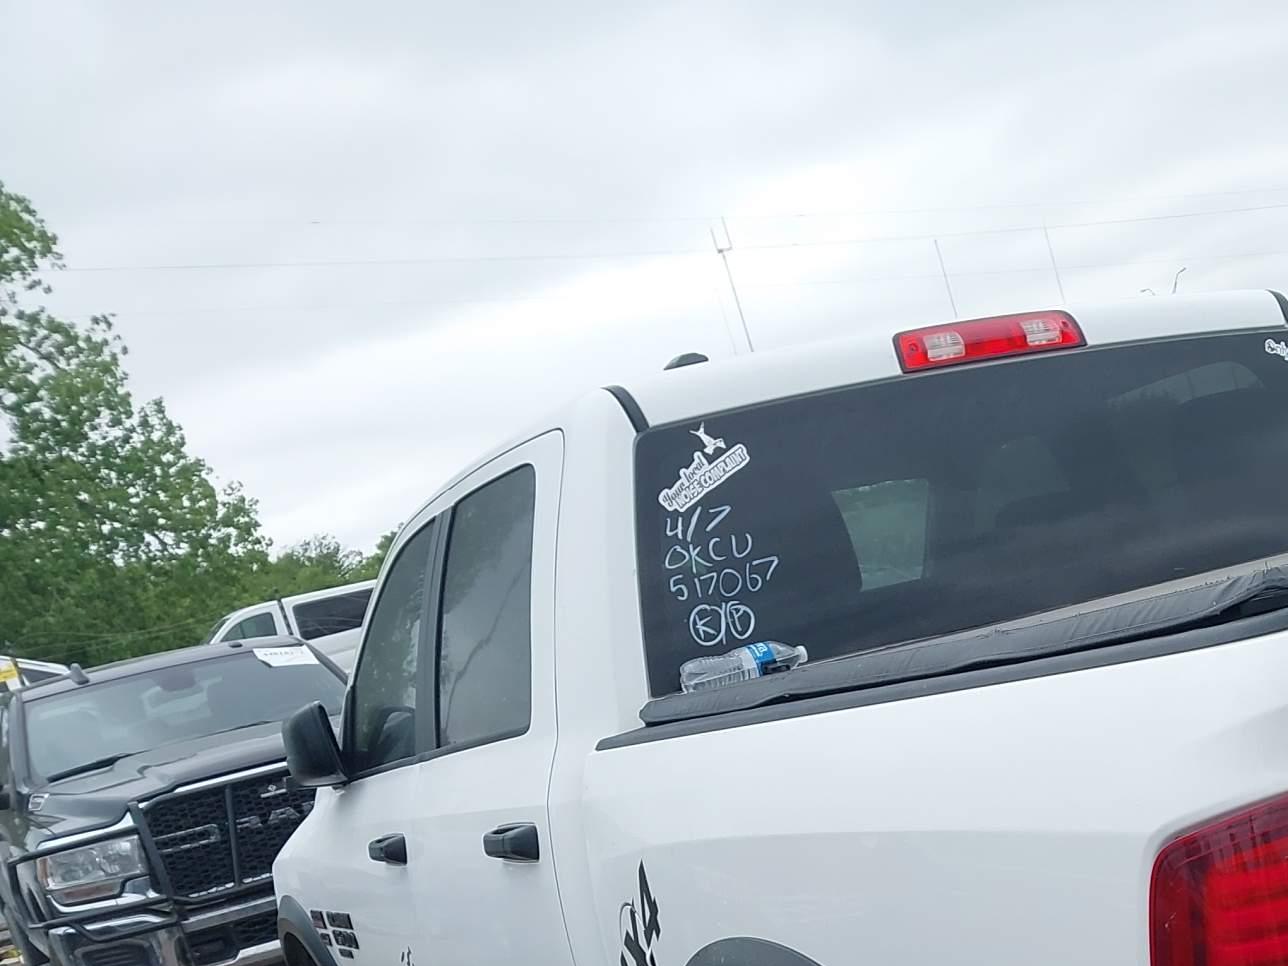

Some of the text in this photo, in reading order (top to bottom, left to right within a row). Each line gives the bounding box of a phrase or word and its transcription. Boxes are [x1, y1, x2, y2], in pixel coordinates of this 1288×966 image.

[662, 455, 706, 507] Your local
[674, 447, 747, 510] NOISE COMPLAINT
[664, 505, 732, 541] 4/7
[670, 556, 779, 601] 517067
